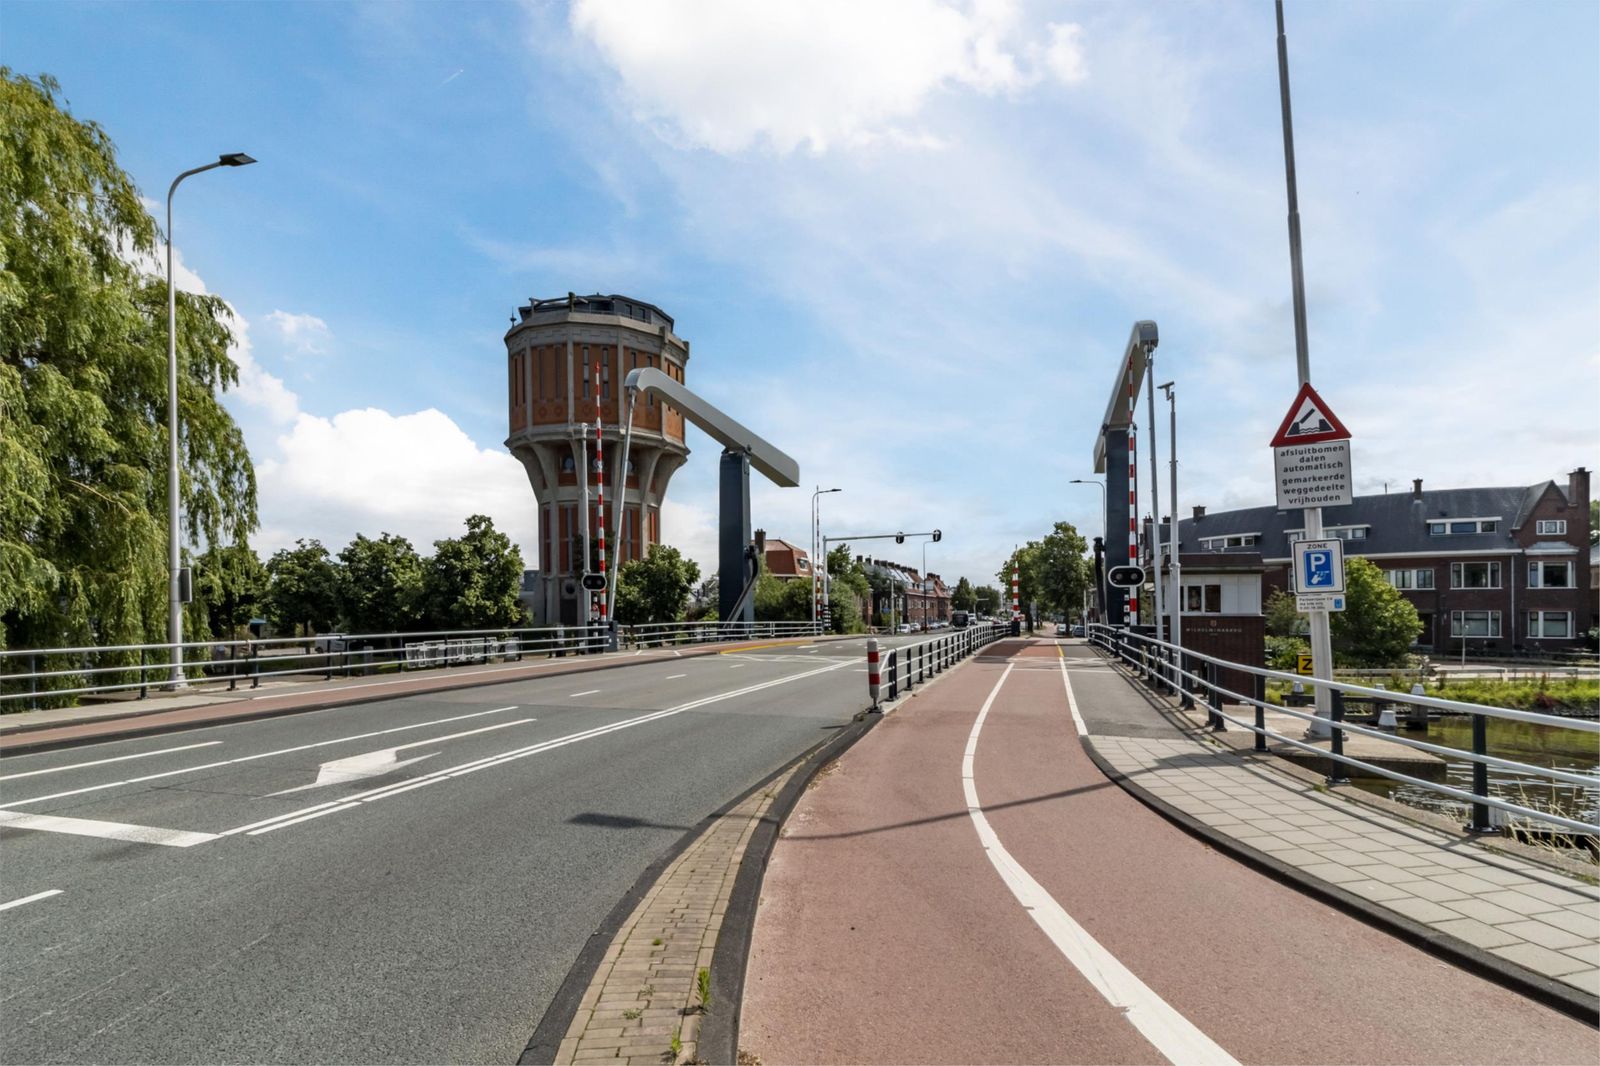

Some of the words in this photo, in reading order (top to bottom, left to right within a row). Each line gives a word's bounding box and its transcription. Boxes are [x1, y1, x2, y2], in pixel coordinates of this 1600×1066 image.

[1280, 445, 1344, 457] afsluitbomen
[1299, 455, 1326, 464] dalen
[1283, 461, 1343, 473] automatisch
[1282, 473, 1345, 486] gemarkeerde
[1283, 483, 1345, 495] weggedeelte
[1288, 494, 1341, 505] vrijhouden
[1310, 553, 1326, 572] P
